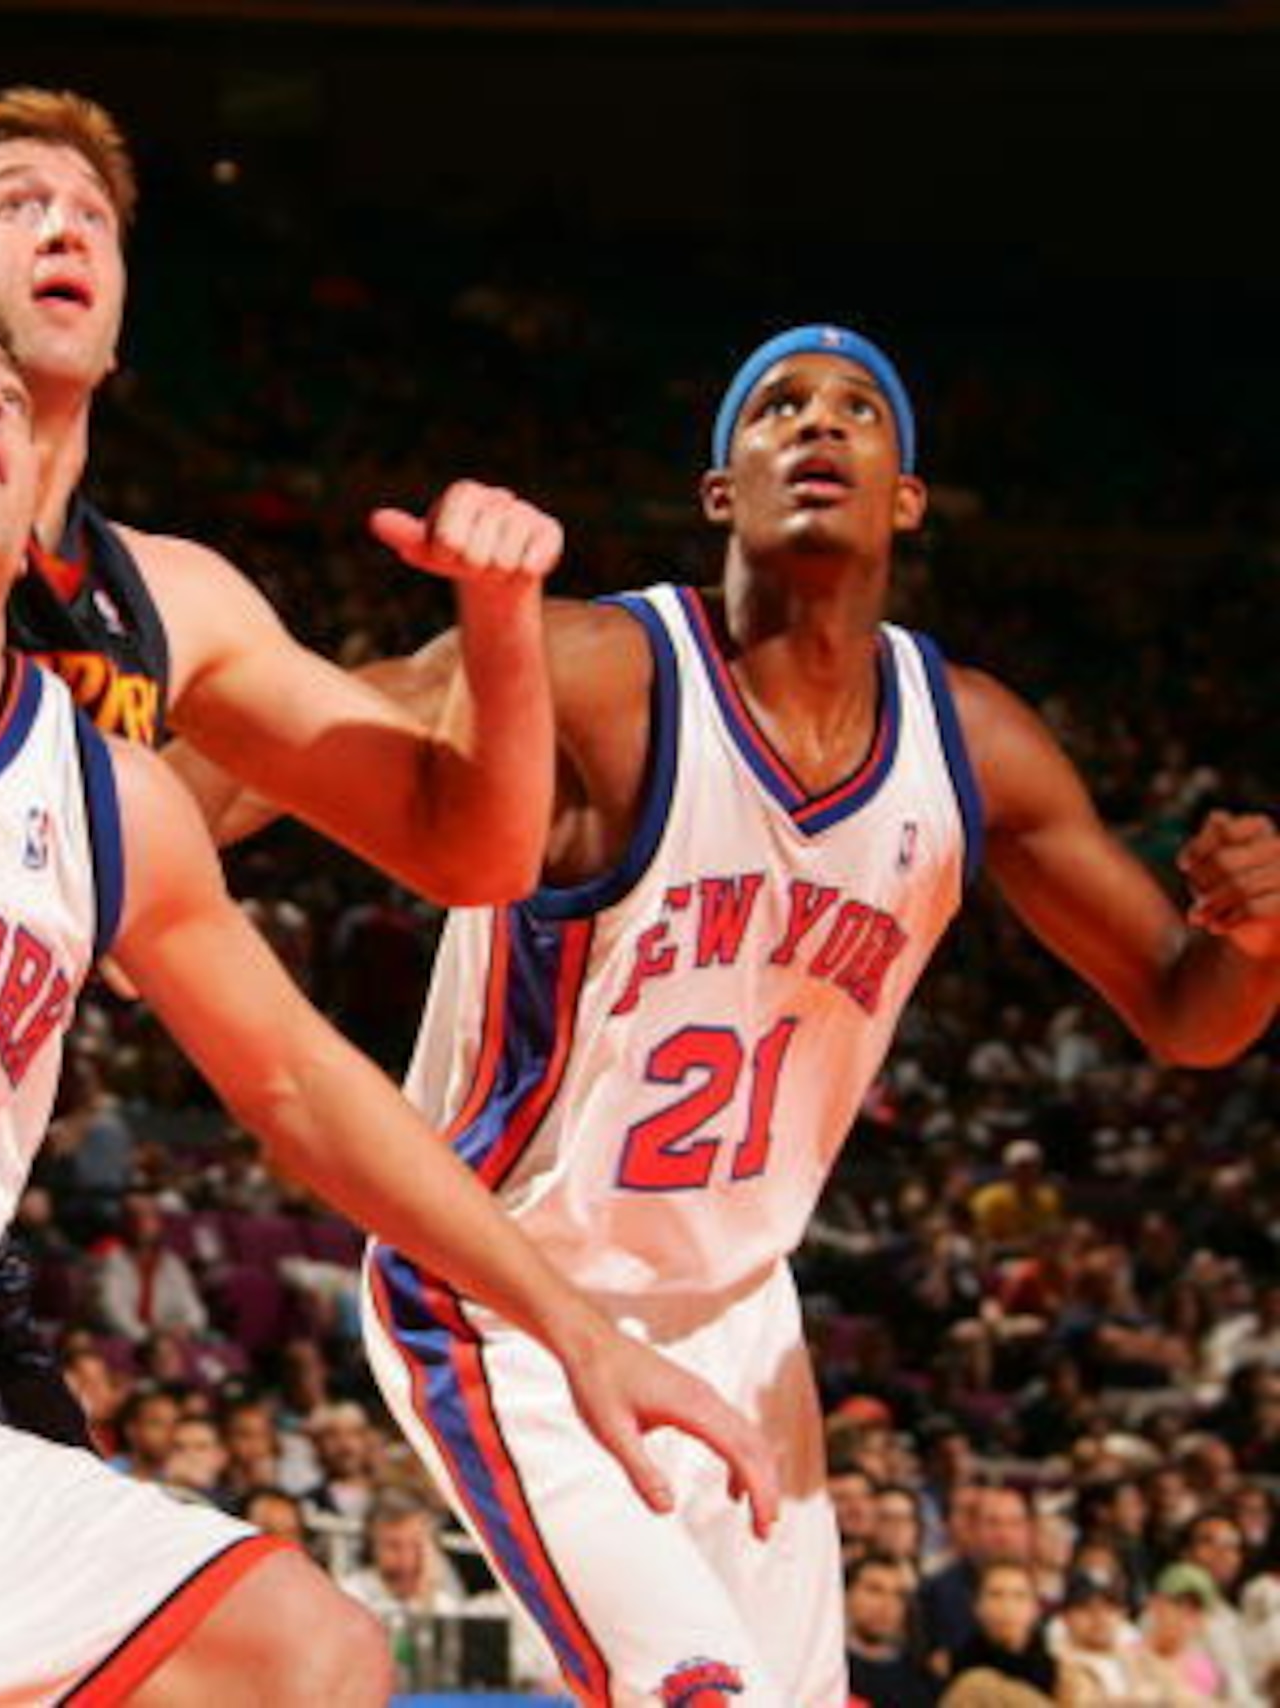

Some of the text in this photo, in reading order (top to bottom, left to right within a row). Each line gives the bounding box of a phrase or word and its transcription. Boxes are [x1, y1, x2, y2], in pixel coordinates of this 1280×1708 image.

[609, 874, 908, 1017] EW YOR
[615, 1016, 799, 1192] 21
